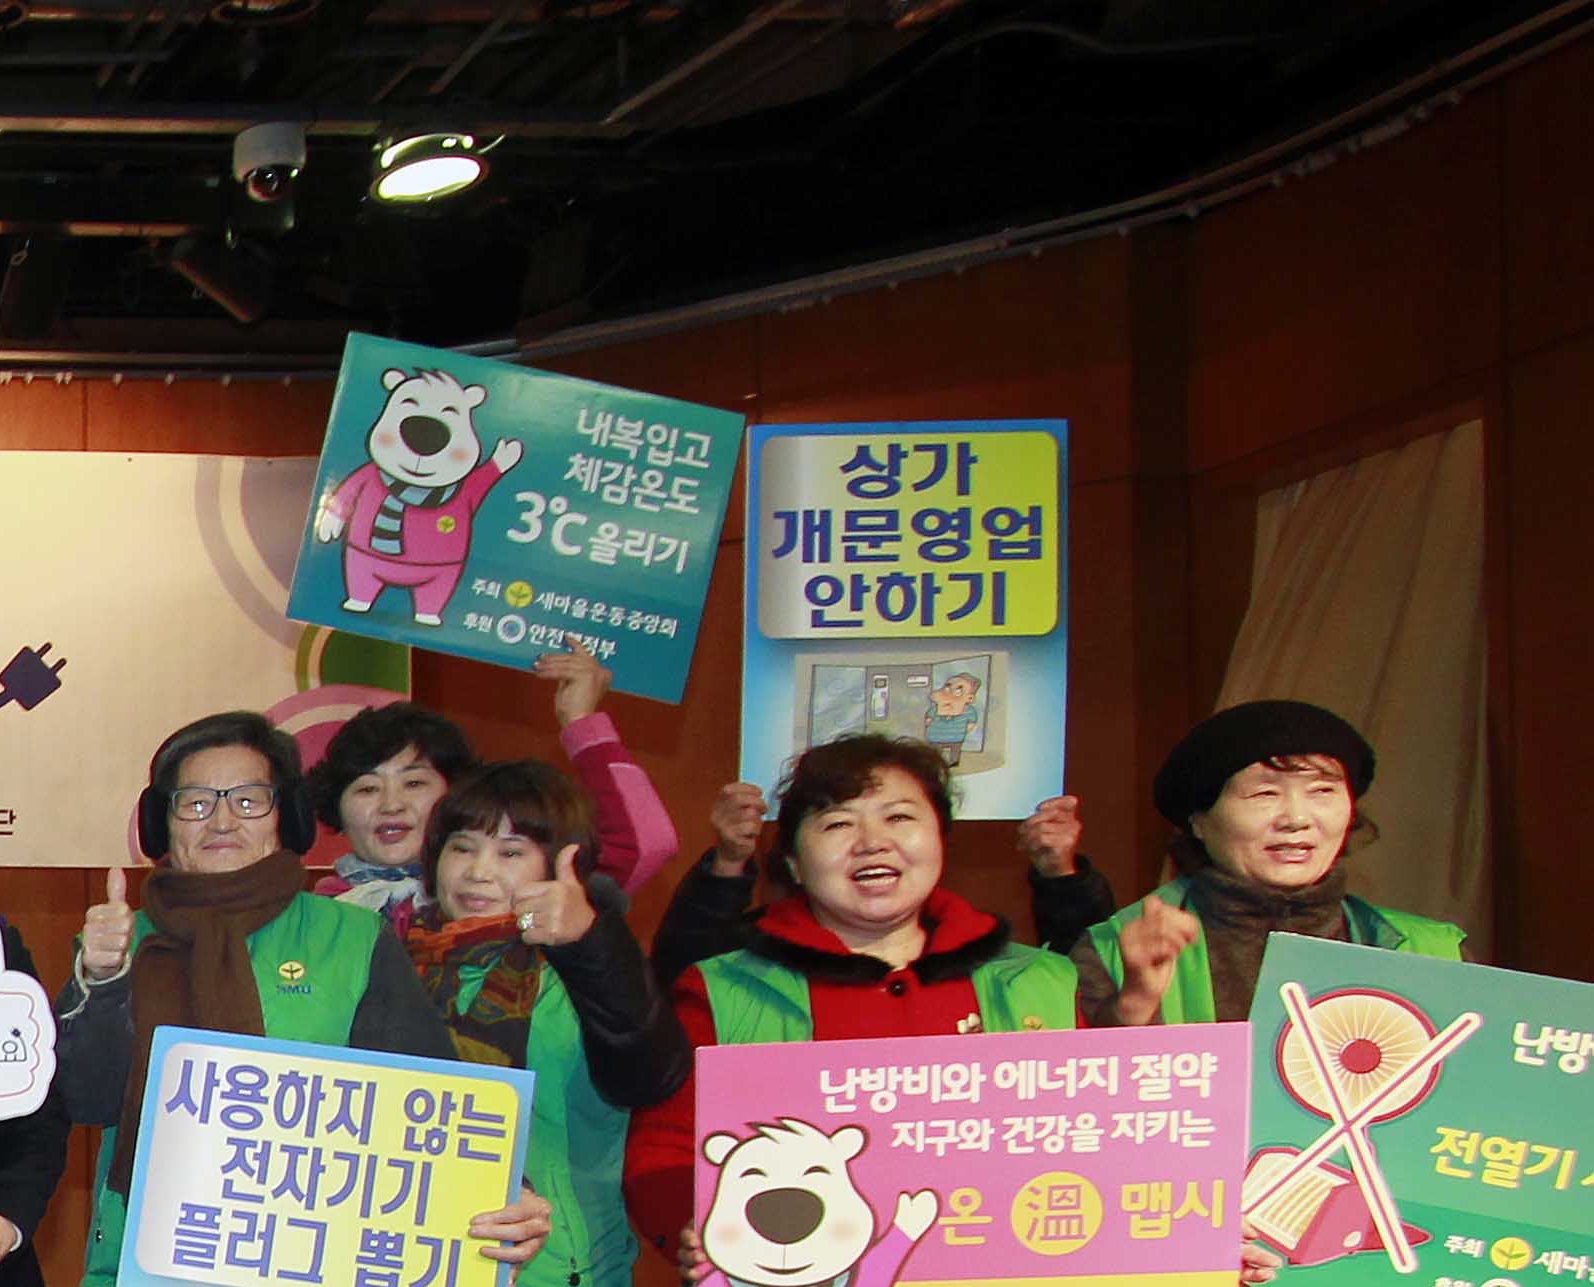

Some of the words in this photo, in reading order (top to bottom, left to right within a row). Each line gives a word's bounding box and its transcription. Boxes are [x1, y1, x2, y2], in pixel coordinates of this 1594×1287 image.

[577, 408, 712, 469] 내복입고
[564, 452, 701, 515] 체감온도
[840, 441, 979, 500] 상가
[771, 505, 1044, 564] 개문영업
[463, 611, 493, 633] 후원
[472, 578, 502, 600] 주최
[534, 591, 679, 639] 새마을운동중앙회
[804, 571, 1008, 629] 안하기
[164, 1058, 378, 1146] 사용하지
[403, 1087, 508, 1163] 않는
[819, 1060, 986, 1115] 난방비와
[993, 1054, 1119, 1099] 에너지
[1129, 1050, 1219, 1101] 절약
[891, 1116, 994, 1157] 지구와
[1001, 1113, 1104, 1156] 건강을
[1109, 1108, 1215, 1148] 지키는
[1430, 1125, 1578, 1191] 전열기
[219, 1135, 434, 1228] 전자기기
[938, 1186, 994, 1247] 온
[1022, 1178, 1093, 1246] 溫
[1120, 1178, 1225, 1241] 맵시
[171, 1201, 329, 1286] 플러그
[1443, 1233, 1485, 1259] 주최
[1533, 1250, 1594, 1283] 새마
